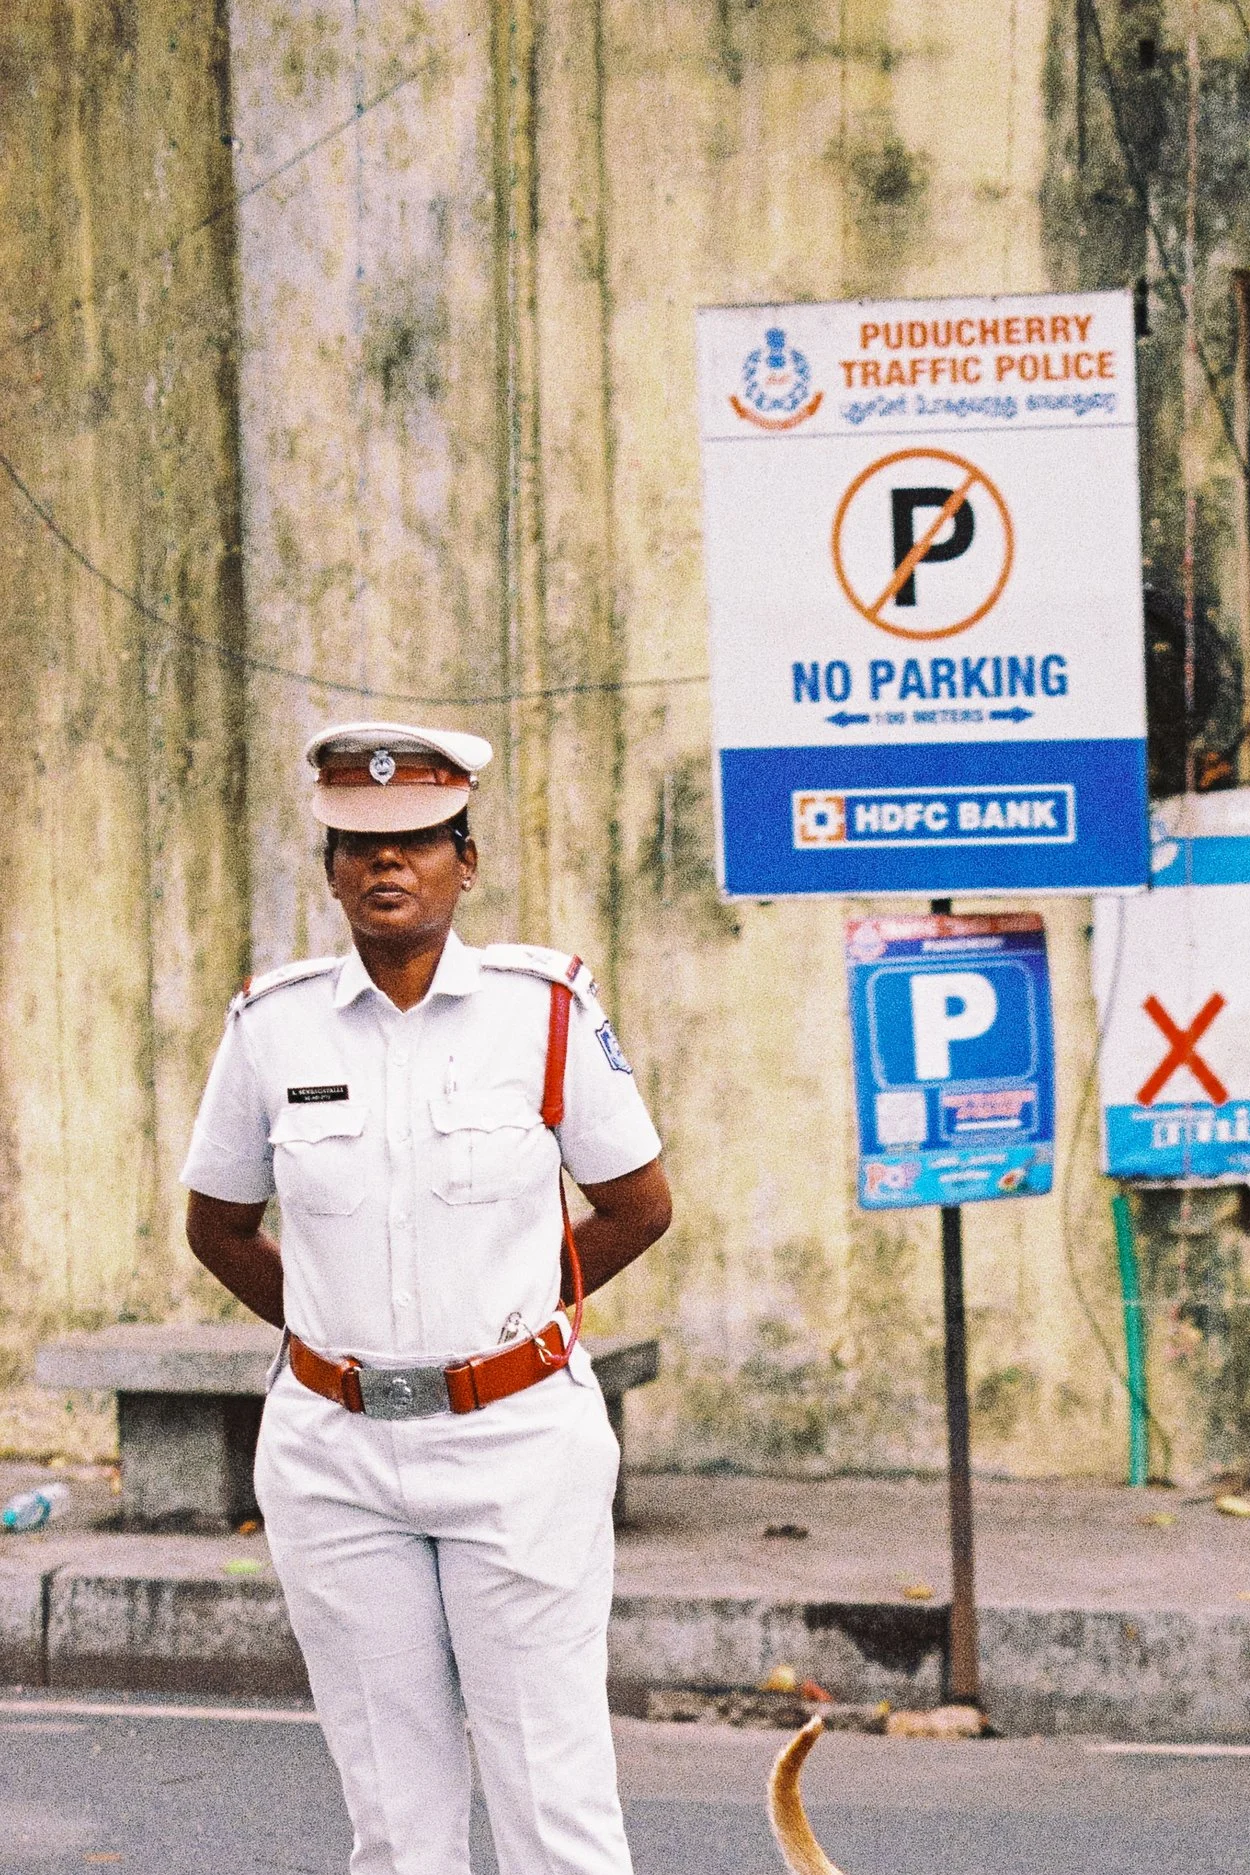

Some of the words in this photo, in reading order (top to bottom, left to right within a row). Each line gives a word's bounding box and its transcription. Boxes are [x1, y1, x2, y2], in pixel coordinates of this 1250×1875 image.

[859, 314, 1093, 350] PUDUCHERRY
[839, 354, 983, 389] TRAFFIC
[995, 350, 1117, 382] POLICE
[891, 486, 976, 607] P
[792, 659, 853, 702] NO
[870, 653, 1069, 700] PARKING
[855, 800, 949, 833] HDFC
[958, 798, 1057, 830] BANK
[910, 971, 998, 1082] P
